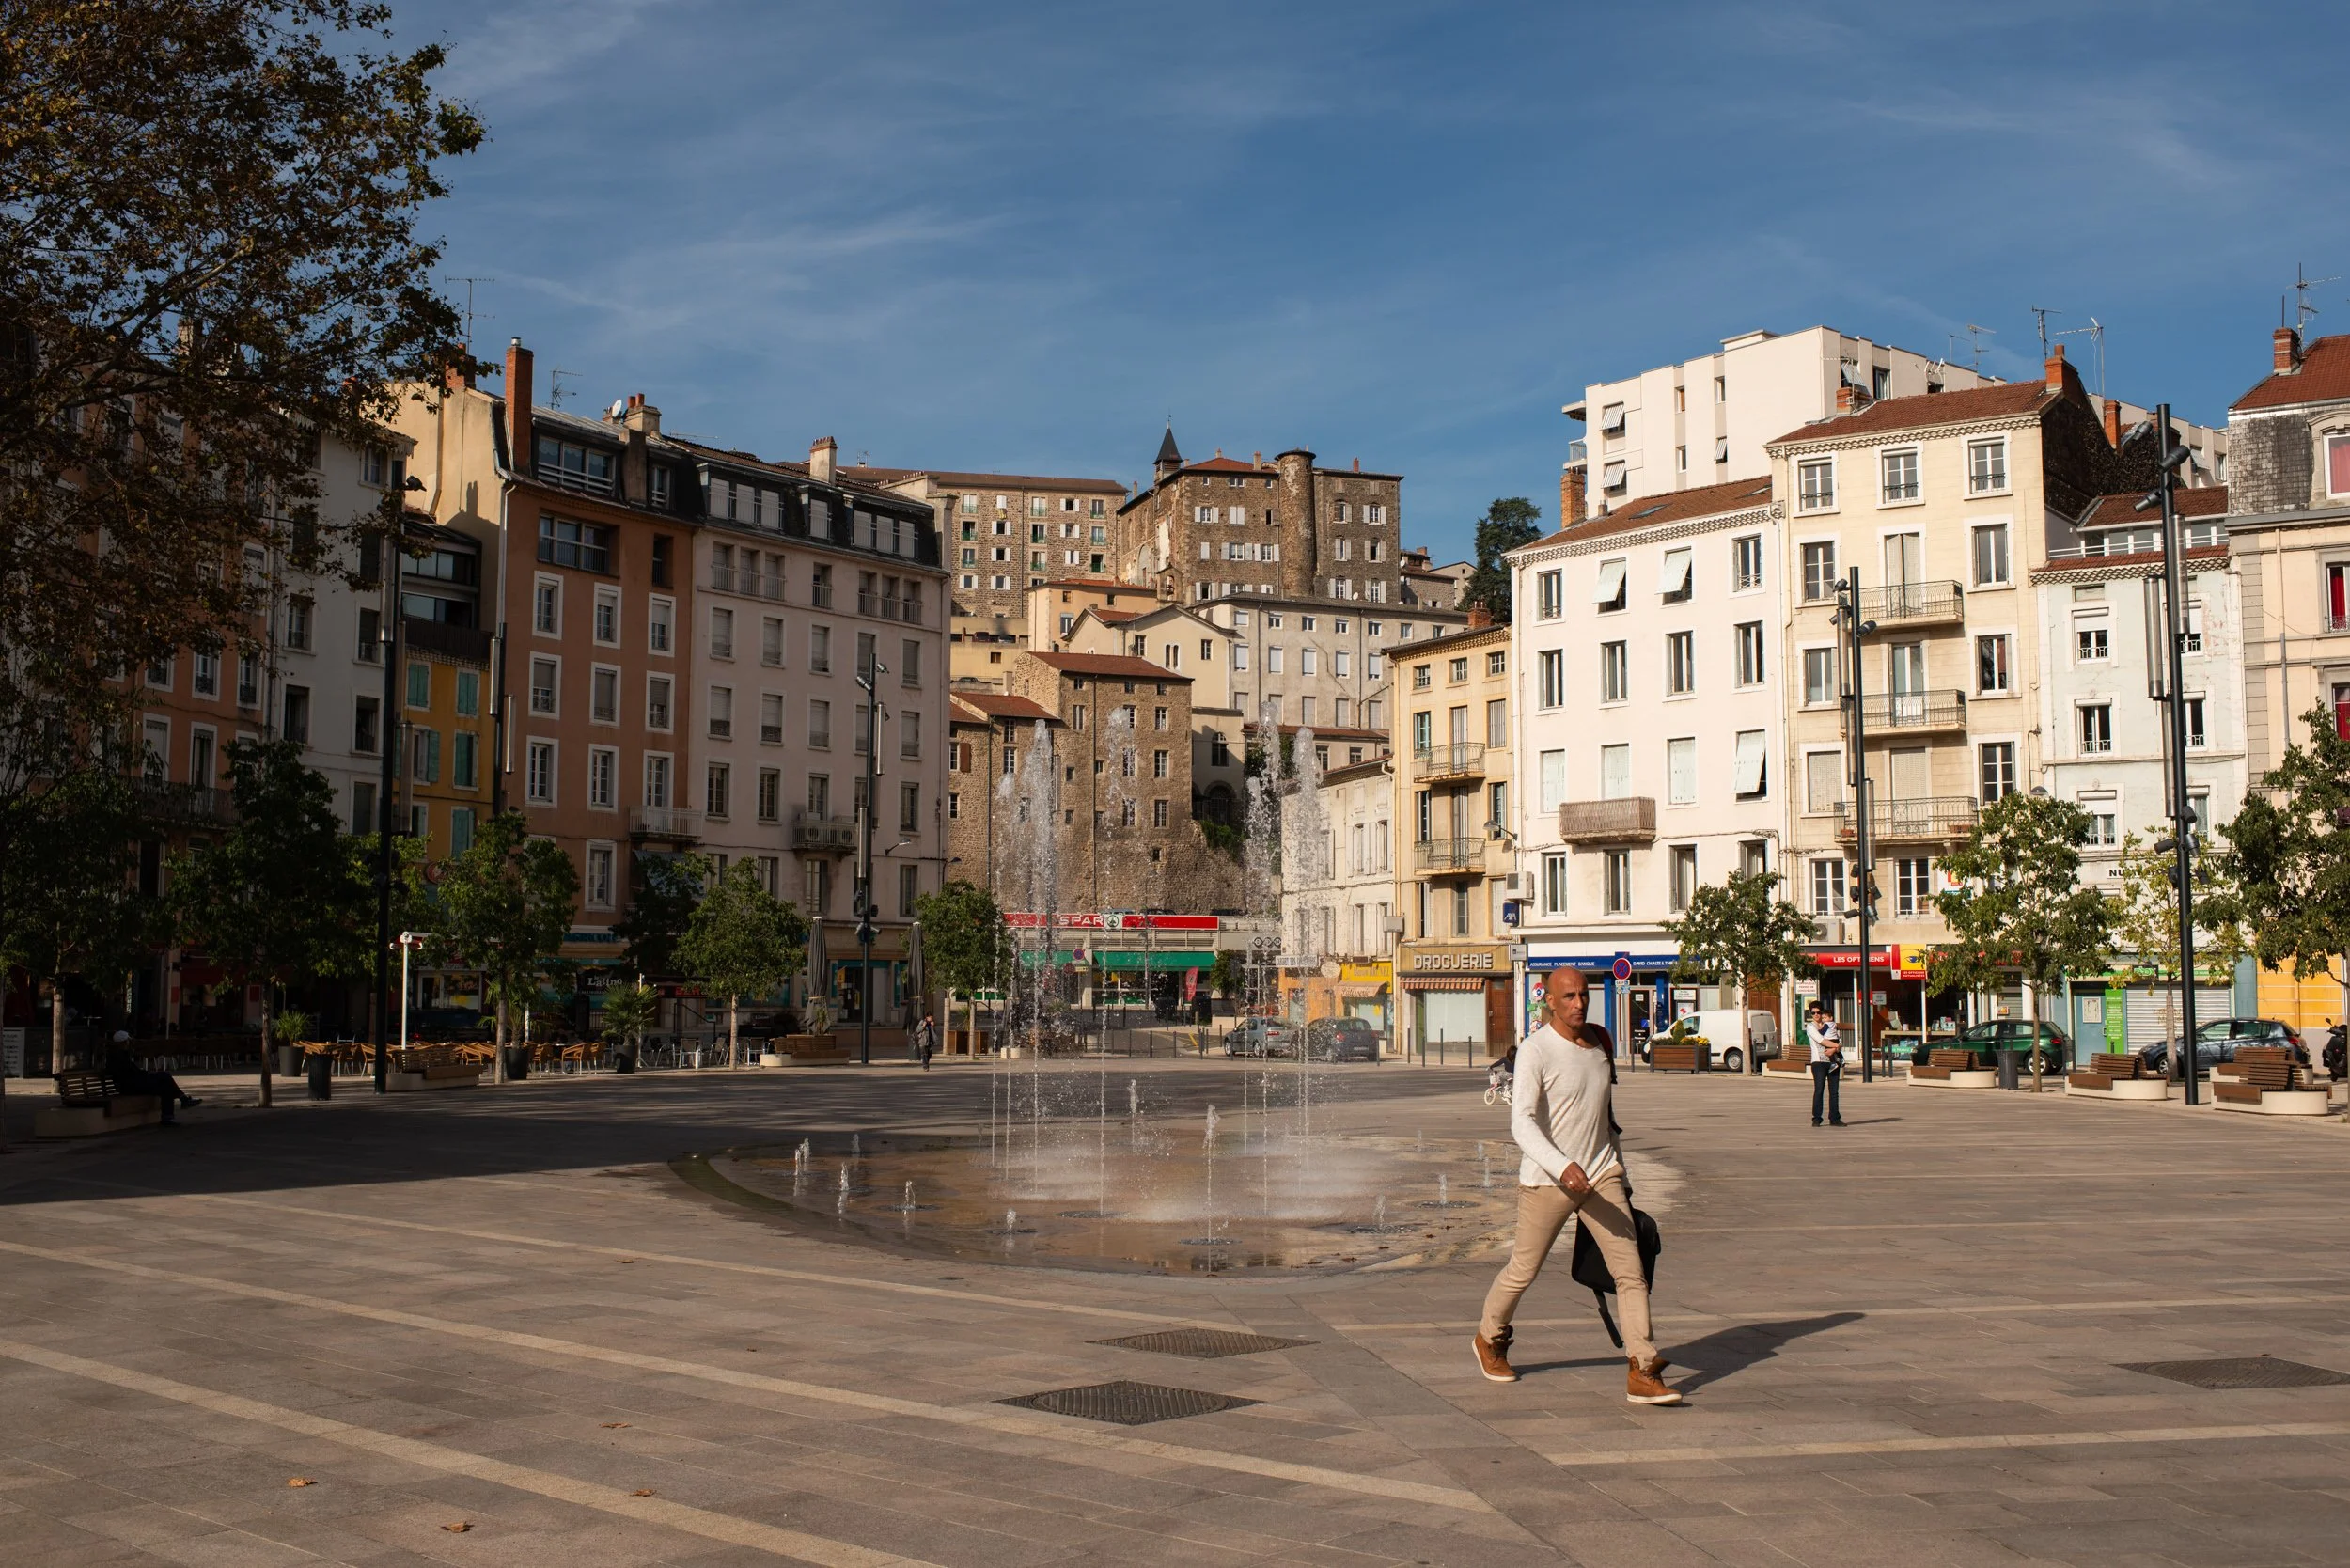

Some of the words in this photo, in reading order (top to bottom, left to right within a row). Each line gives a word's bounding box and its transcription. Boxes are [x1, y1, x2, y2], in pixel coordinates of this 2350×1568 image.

[1059, 916, 1104, 926] SPAR
[1504, 912, 1516, 921] AXA
[1414, 953, 1493, 969] DROGUERIE
[588, 978, 622, 987] Latino
